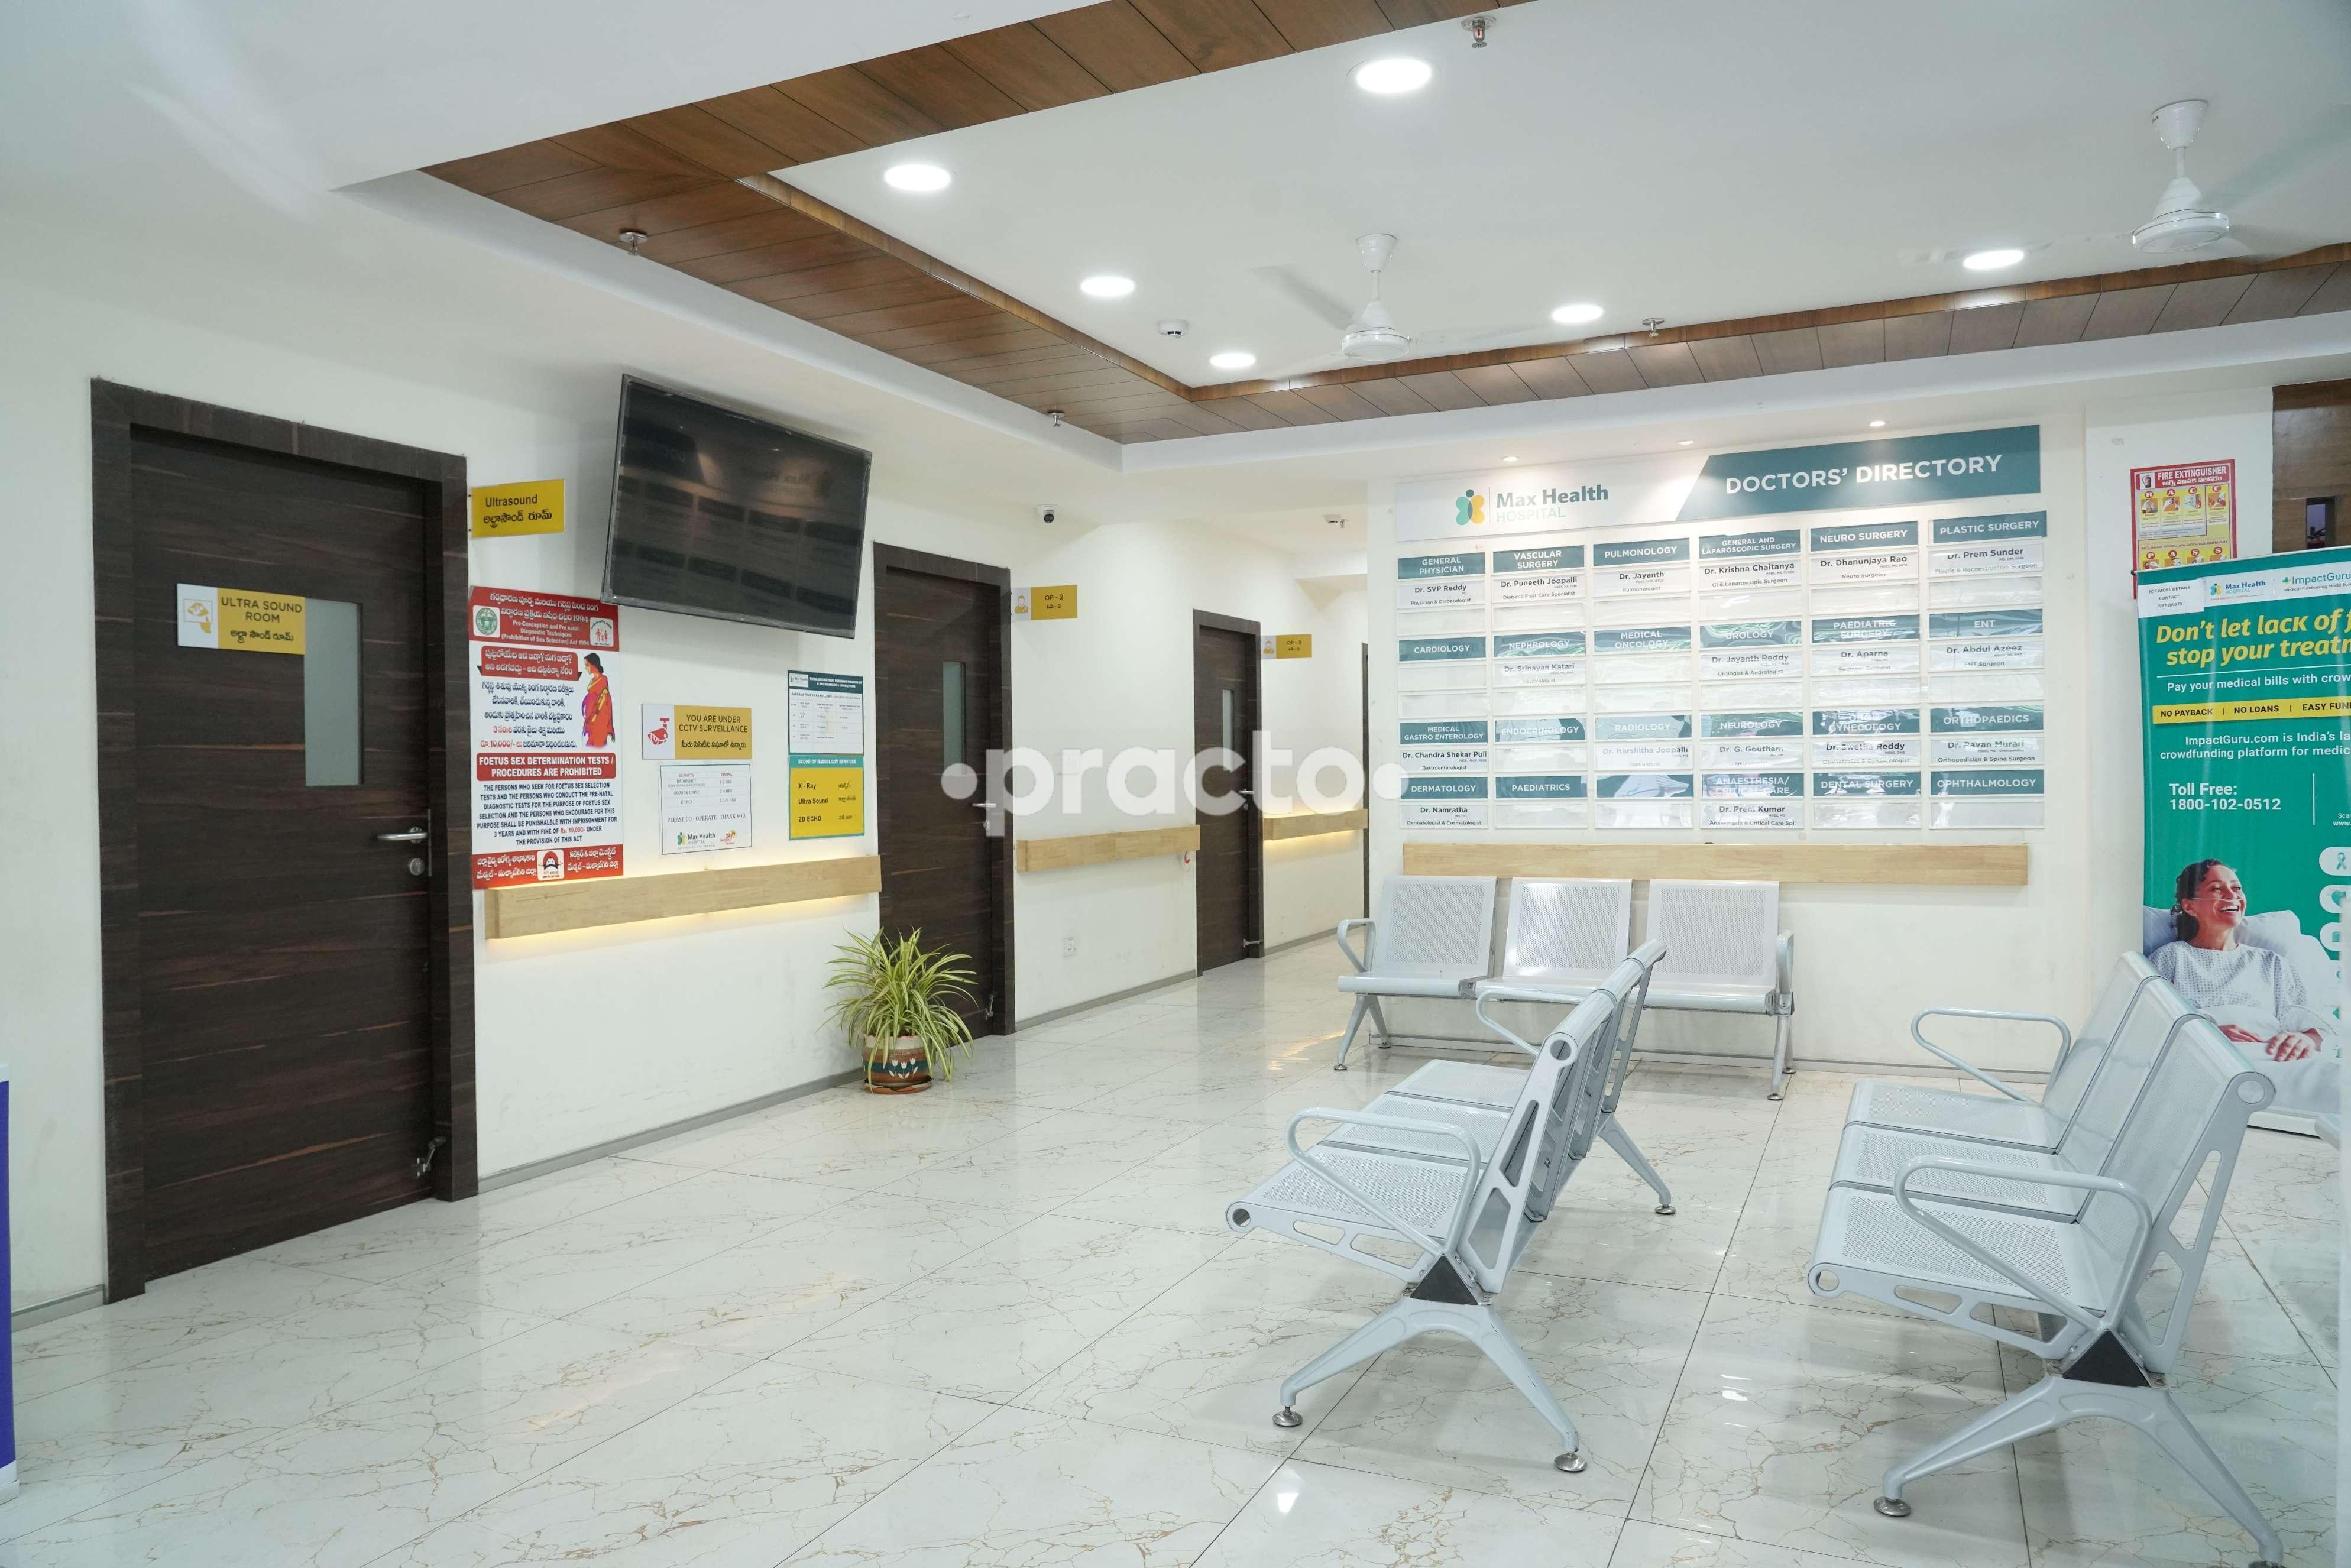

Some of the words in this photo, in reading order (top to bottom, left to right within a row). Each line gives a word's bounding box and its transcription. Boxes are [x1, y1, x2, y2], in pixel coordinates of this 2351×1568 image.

[1855, 454, 2002, 484] DIRECTORY
[2158, 472, 2172, 480] FIRE
[2175, 467, 2226, 478] EXTINGUISHER
[485, 494, 537, 507] Ultrasound
[1497, 491, 1537, 508] Max
[1542, 485, 1608, 504] Health
[1497, 507, 1566, 522] HOSPITAL
[1940, 525, 1984, 535] PLASTIC
[1987, 520, 2039, 532] SURGERY
[1820, 533, 1855, 543] NEURO
[1859, 530, 1908, 540] SURGERY
[1514, 550, 1562, 561] VASCULAR
[1605, 546, 1677, 558] PULMONOLOGY
[1422, 556, 1461, 566] GENERAL
[1517, 559, 1559, 569] SURGERY
[1836, 557, 1887, 566] Dhanunjaya
[1419, 566, 1464, 575] PHYSICIAN
[1633, 571, 1664, 579] Jayanth
[1514, 578, 1544, 587] Puneeth
[1547, 576, 1577, 585] Joopalli
[2241, 581, 2266, 589] Health
[221, 597, 260, 608] ULTRA
[263, 601, 302, 613] SOUND
[245, 612, 280, 623] ROOM
[1974, 620, 1996, 629] ENT
[2220, 618, 2250, 639] let
[2258, 615, 2308, 636] lack
[2314, 608, 2344, 635] of
[1414, 645, 1470, 654] CARDIOLOGY
[1963, 645, 1990, 653] Abdul
[2167, 647, 2214, 668] stop
[2220, 644, 2274, 666] your
[2167, 682, 2186, 693] Pay
[2190, 681, 2213, 691] your
[2217, 677, 2261, 688] medical
[2264, 676, 2288, 685] bills
[2292, 674, 2317, 684] with
[2249, 705, 2279, 714] LOANS
[686, 714, 701, 723] YOU
[1943, 715, 2029, 724] ORTHOPAEDICS
[2185, 734, 2278, 747] ImpactGuru.com
[2283, 733, 2293, 743] is
[2160, 749, 2234, 760] crowdfunding
[2237, 747, 2287, 759] platform
[2291, 746, 2308, 756] for
[479, 757, 509, 766] FOETUS
[511, 756, 526, 765] SEX
[527, 756, 586, 765] DETERMINATION
[588, 756, 610, 764] TESTS
[491, 768, 542, 777] PROCEDURES
[543, 768, 558, 776] ARE
[560, 767, 602, 776] PROHIBITED
[1937, 779, 2036, 788] OPHTHALMOLOGY
[2169, 783, 2195, 795] Toll
[2200, 782, 2237, 795] Free:
[2170, 798, 2281, 810] 1800-102-0512
